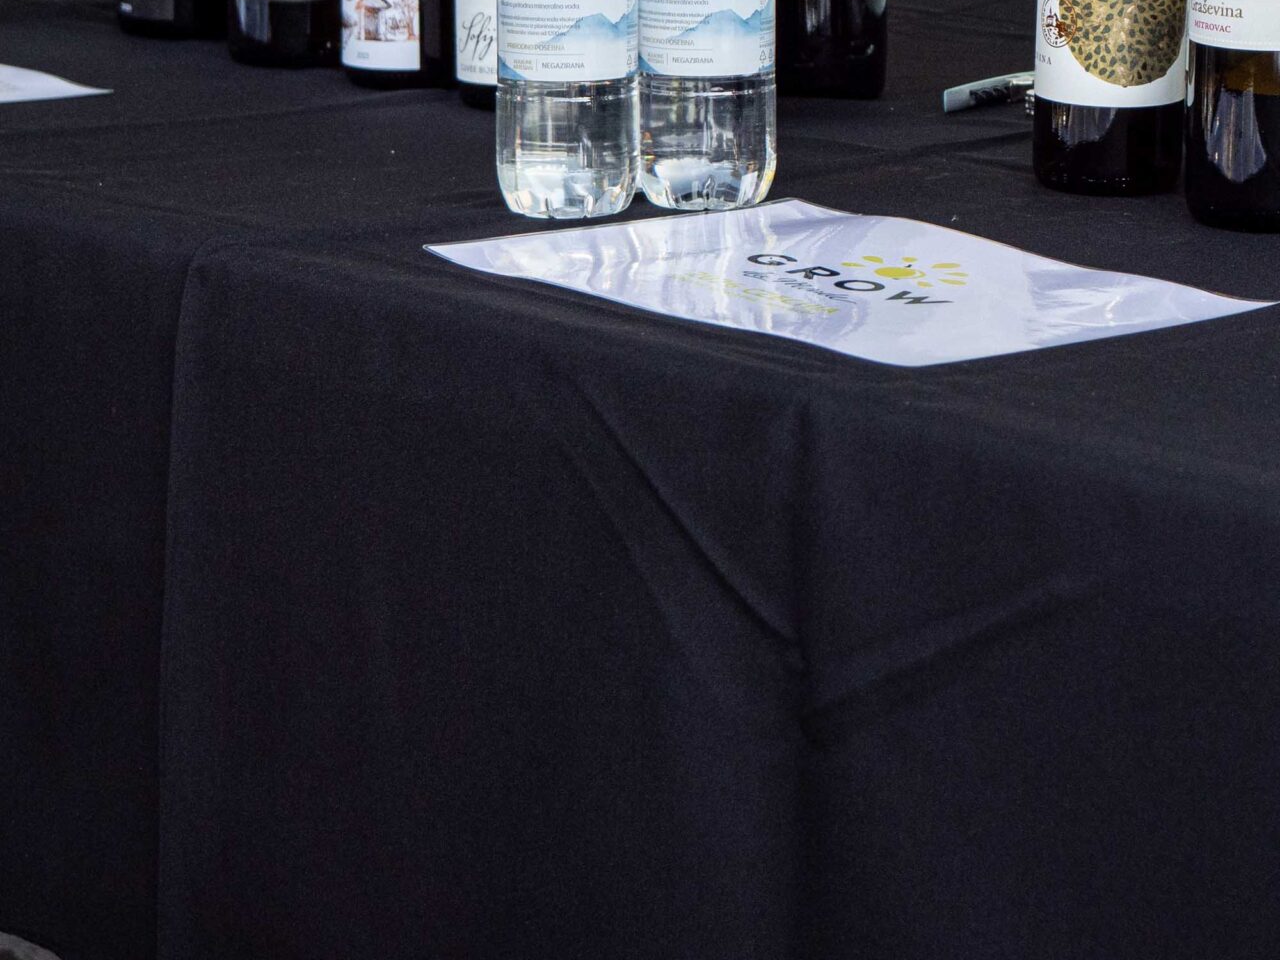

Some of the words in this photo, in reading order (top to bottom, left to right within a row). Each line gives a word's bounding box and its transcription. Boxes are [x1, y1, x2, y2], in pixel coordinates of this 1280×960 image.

[1194, 20, 1231, 33] MITROVAC
[541, 61, 585, 69] NEGAZIRANA
[747, 253, 954, 305] GROW
